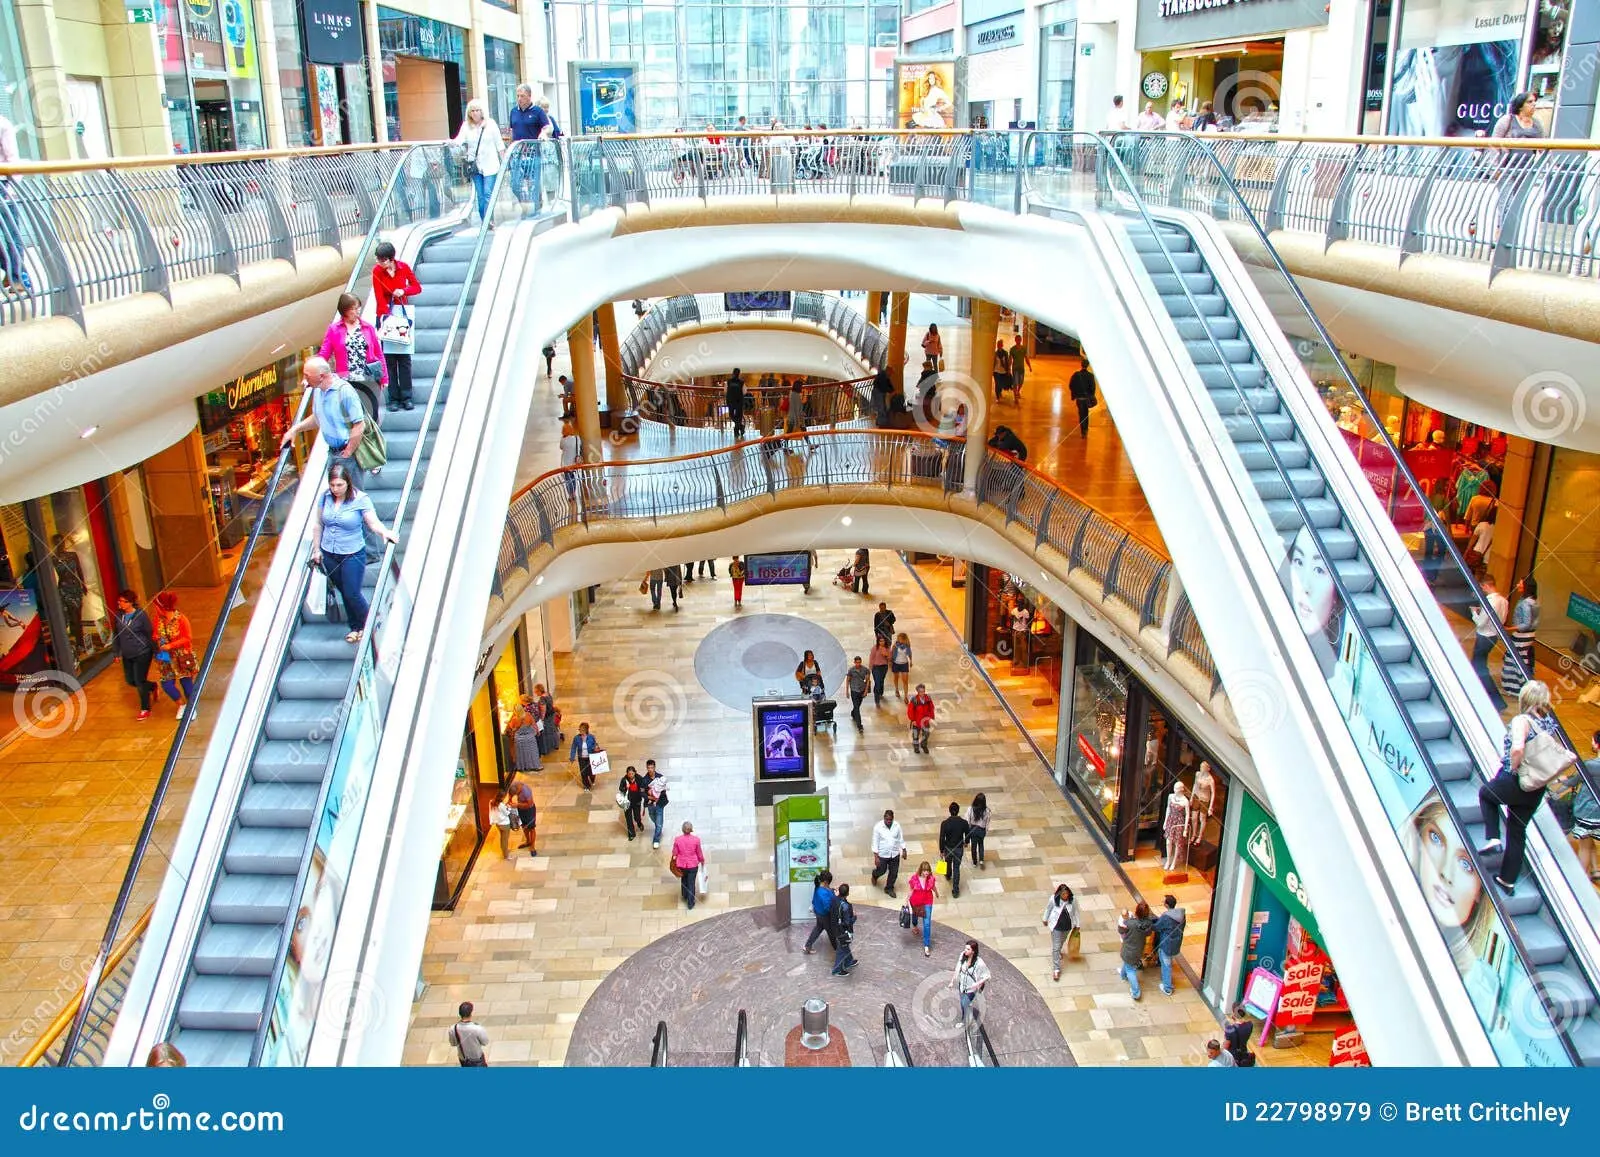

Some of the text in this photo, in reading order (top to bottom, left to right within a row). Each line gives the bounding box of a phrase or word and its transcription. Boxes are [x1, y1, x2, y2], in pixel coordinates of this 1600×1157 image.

[314, 12, 352, 28] LINKS
[1367, 89, 1383, 98] BOSS
[1367, 720, 1415, 783] New.
[818, 799, 827, 817] 1
[1288, 965, 1321, 981] sale
[1282, 995, 1314, 1008] sale
[1337, 1034, 1362, 1051] sal
